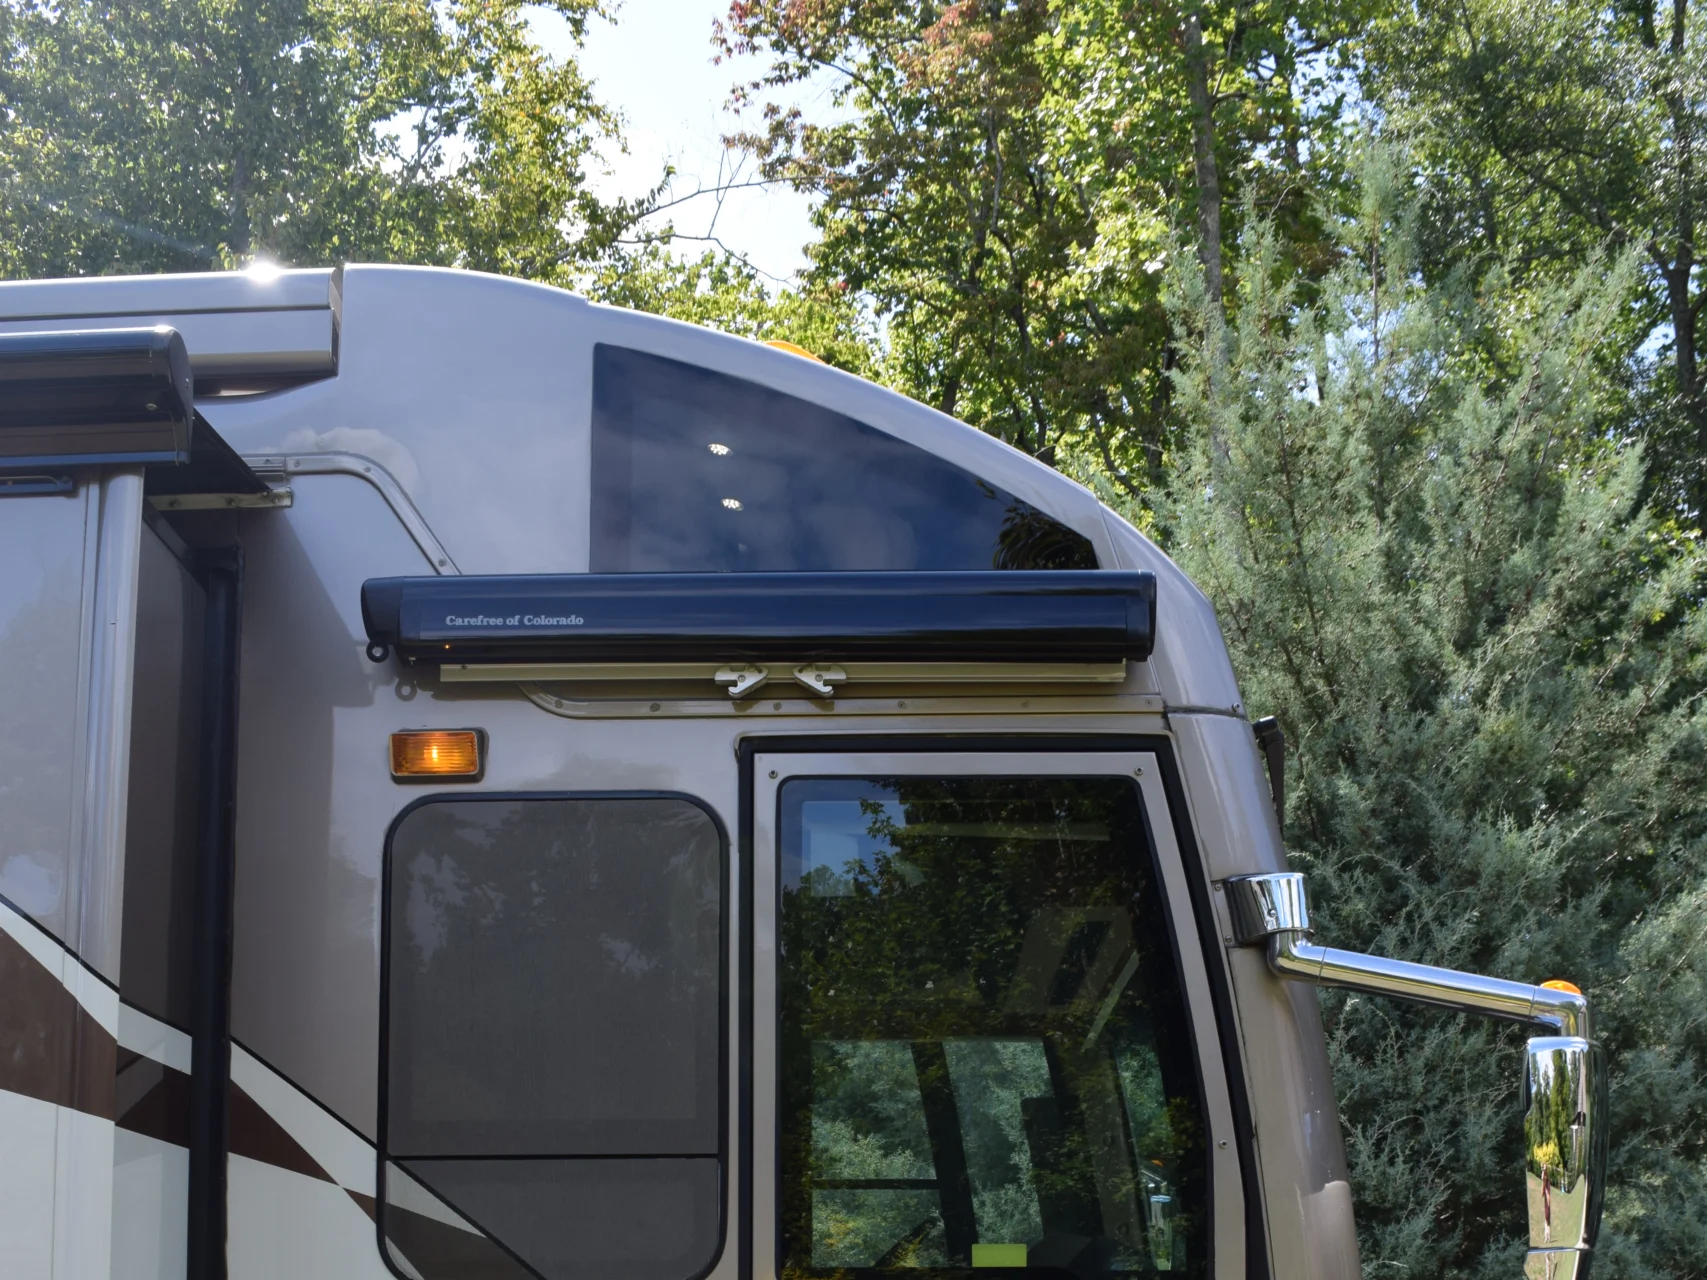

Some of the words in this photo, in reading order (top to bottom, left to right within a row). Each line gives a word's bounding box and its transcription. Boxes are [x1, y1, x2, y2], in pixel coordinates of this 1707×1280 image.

[445, 615, 504, 626] Carefree
[506, 615, 521, 626] of
[523, 615, 584, 626] Colorado
